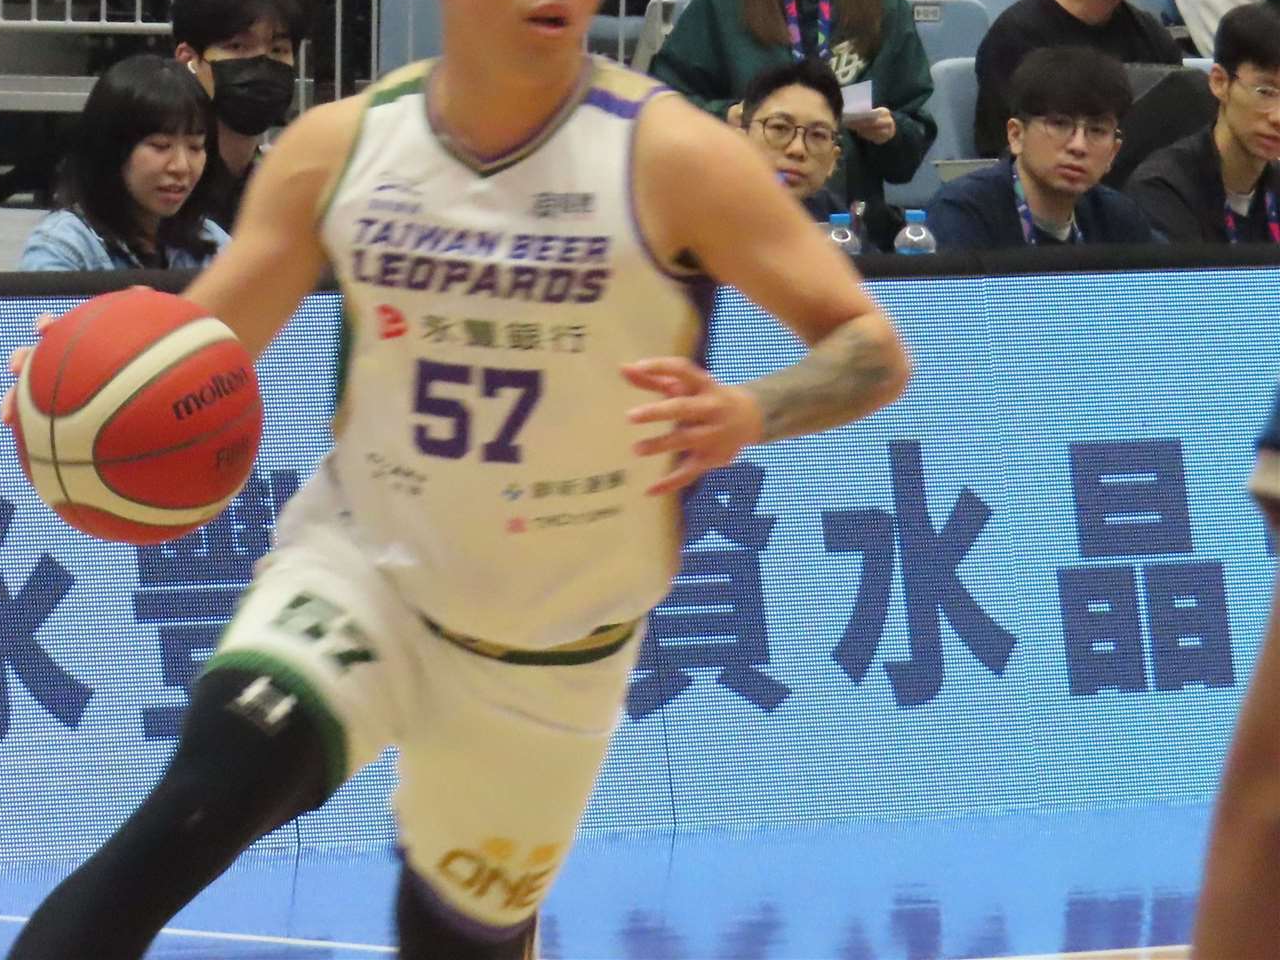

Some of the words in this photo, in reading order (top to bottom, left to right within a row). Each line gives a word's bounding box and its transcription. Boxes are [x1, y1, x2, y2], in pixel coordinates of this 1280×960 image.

[354, 218, 502, 256] TAIWAN
[509, 234, 610, 263] BEER
[351, 249, 611, 304] LEOPARDS
[413, 356, 545, 464] 57
